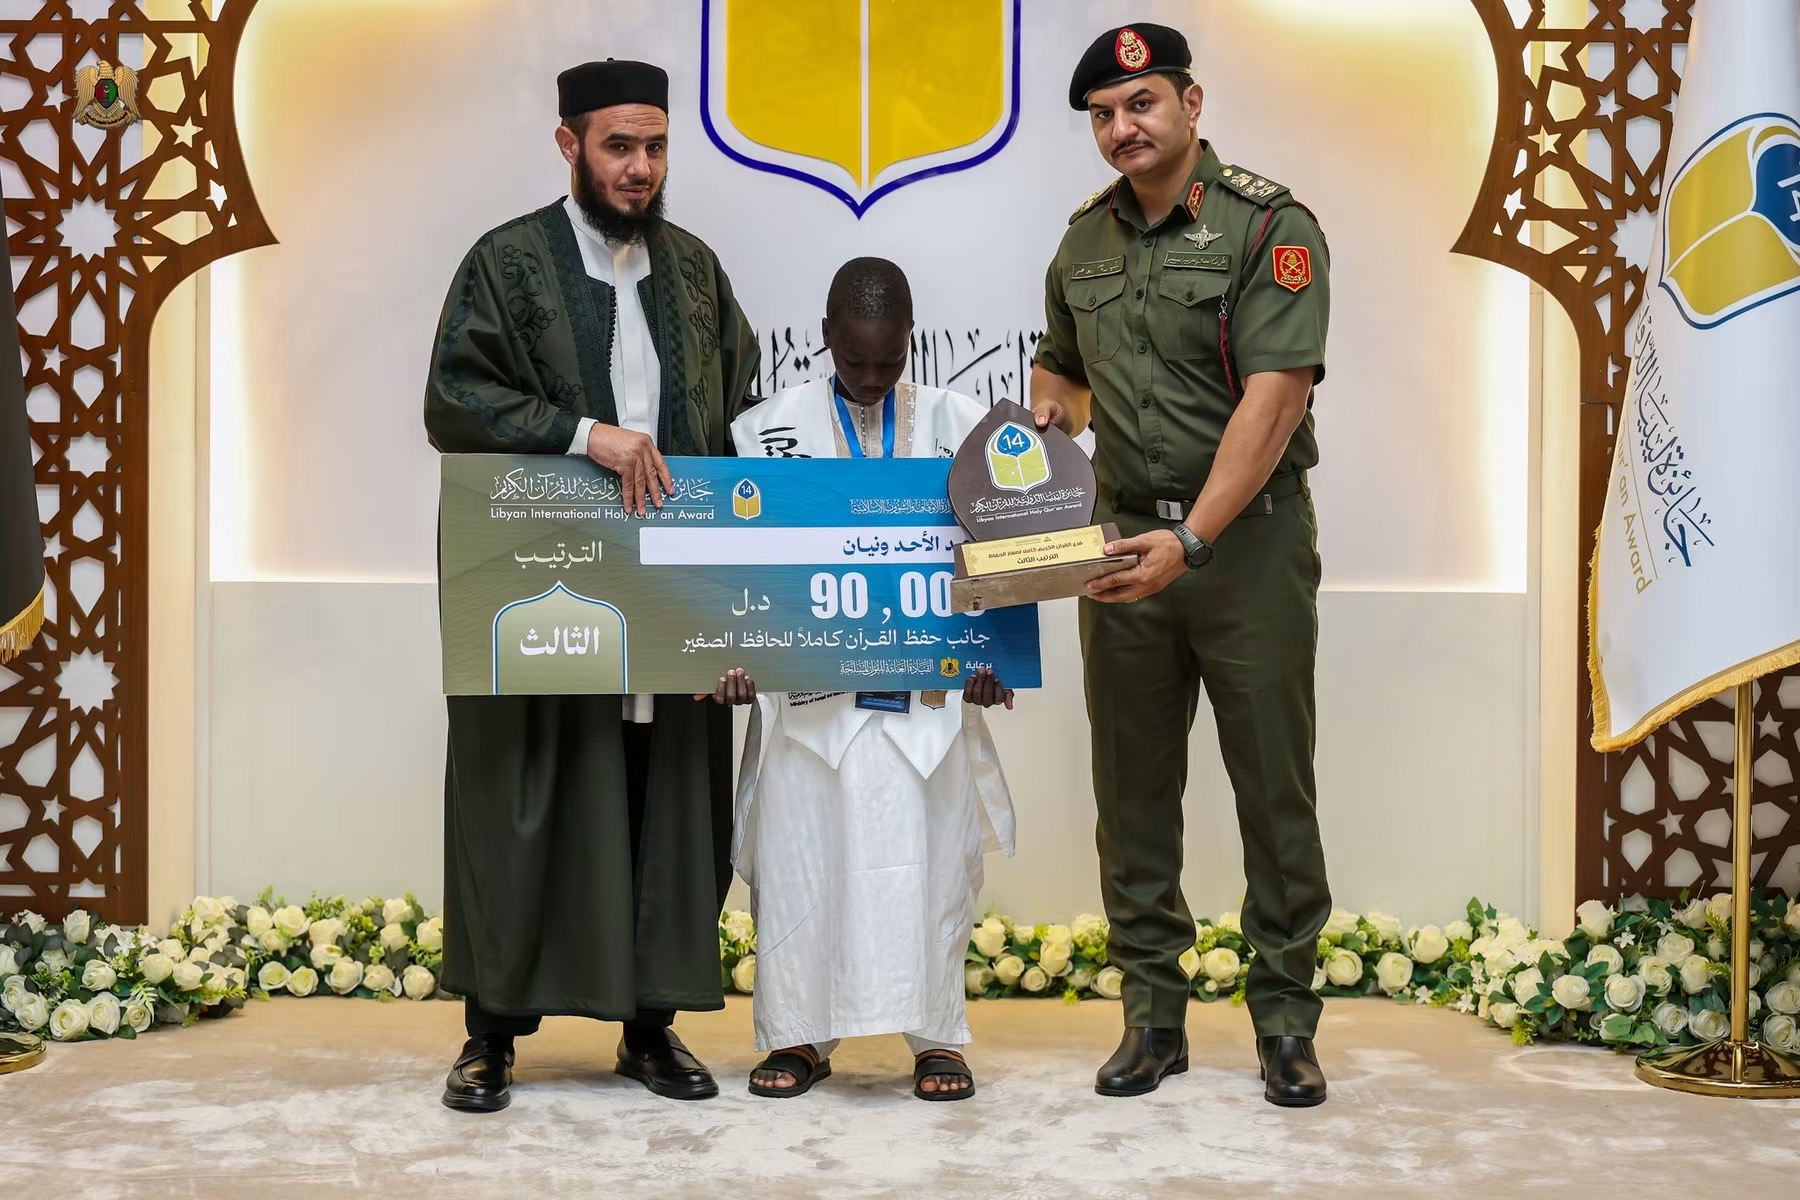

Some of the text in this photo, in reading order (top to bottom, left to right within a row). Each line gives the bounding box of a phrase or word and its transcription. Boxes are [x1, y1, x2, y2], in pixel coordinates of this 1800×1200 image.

[1003, 432, 1025, 450] 14
[740, 484, 753, 495] 14
[490, 508, 527, 521] Libyan
[531, 508, 601, 519] International
[605, 509, 630, 522] Holy
[678, 509, 715, 520] Award
[995, 511, 1029, 520] International
[843, 535, 889, 556] ونيان
[894, 530, 940, 552] الأحد
[514, 540, 603, 570] الترتيب
[1017, 552, 1059, 565] الترتيب الثالث
[1624, 512, 1652, 594] Award
[519, 625, 600, 656] الثالث
[681, 631, 733, 653] الصغير
[738, 629, 793, 648] للحافظ
[845, 627, 897, 651] القرآن
[902, 628, 942, 647] حفظ
[946, 627, 991, 651] جانب
